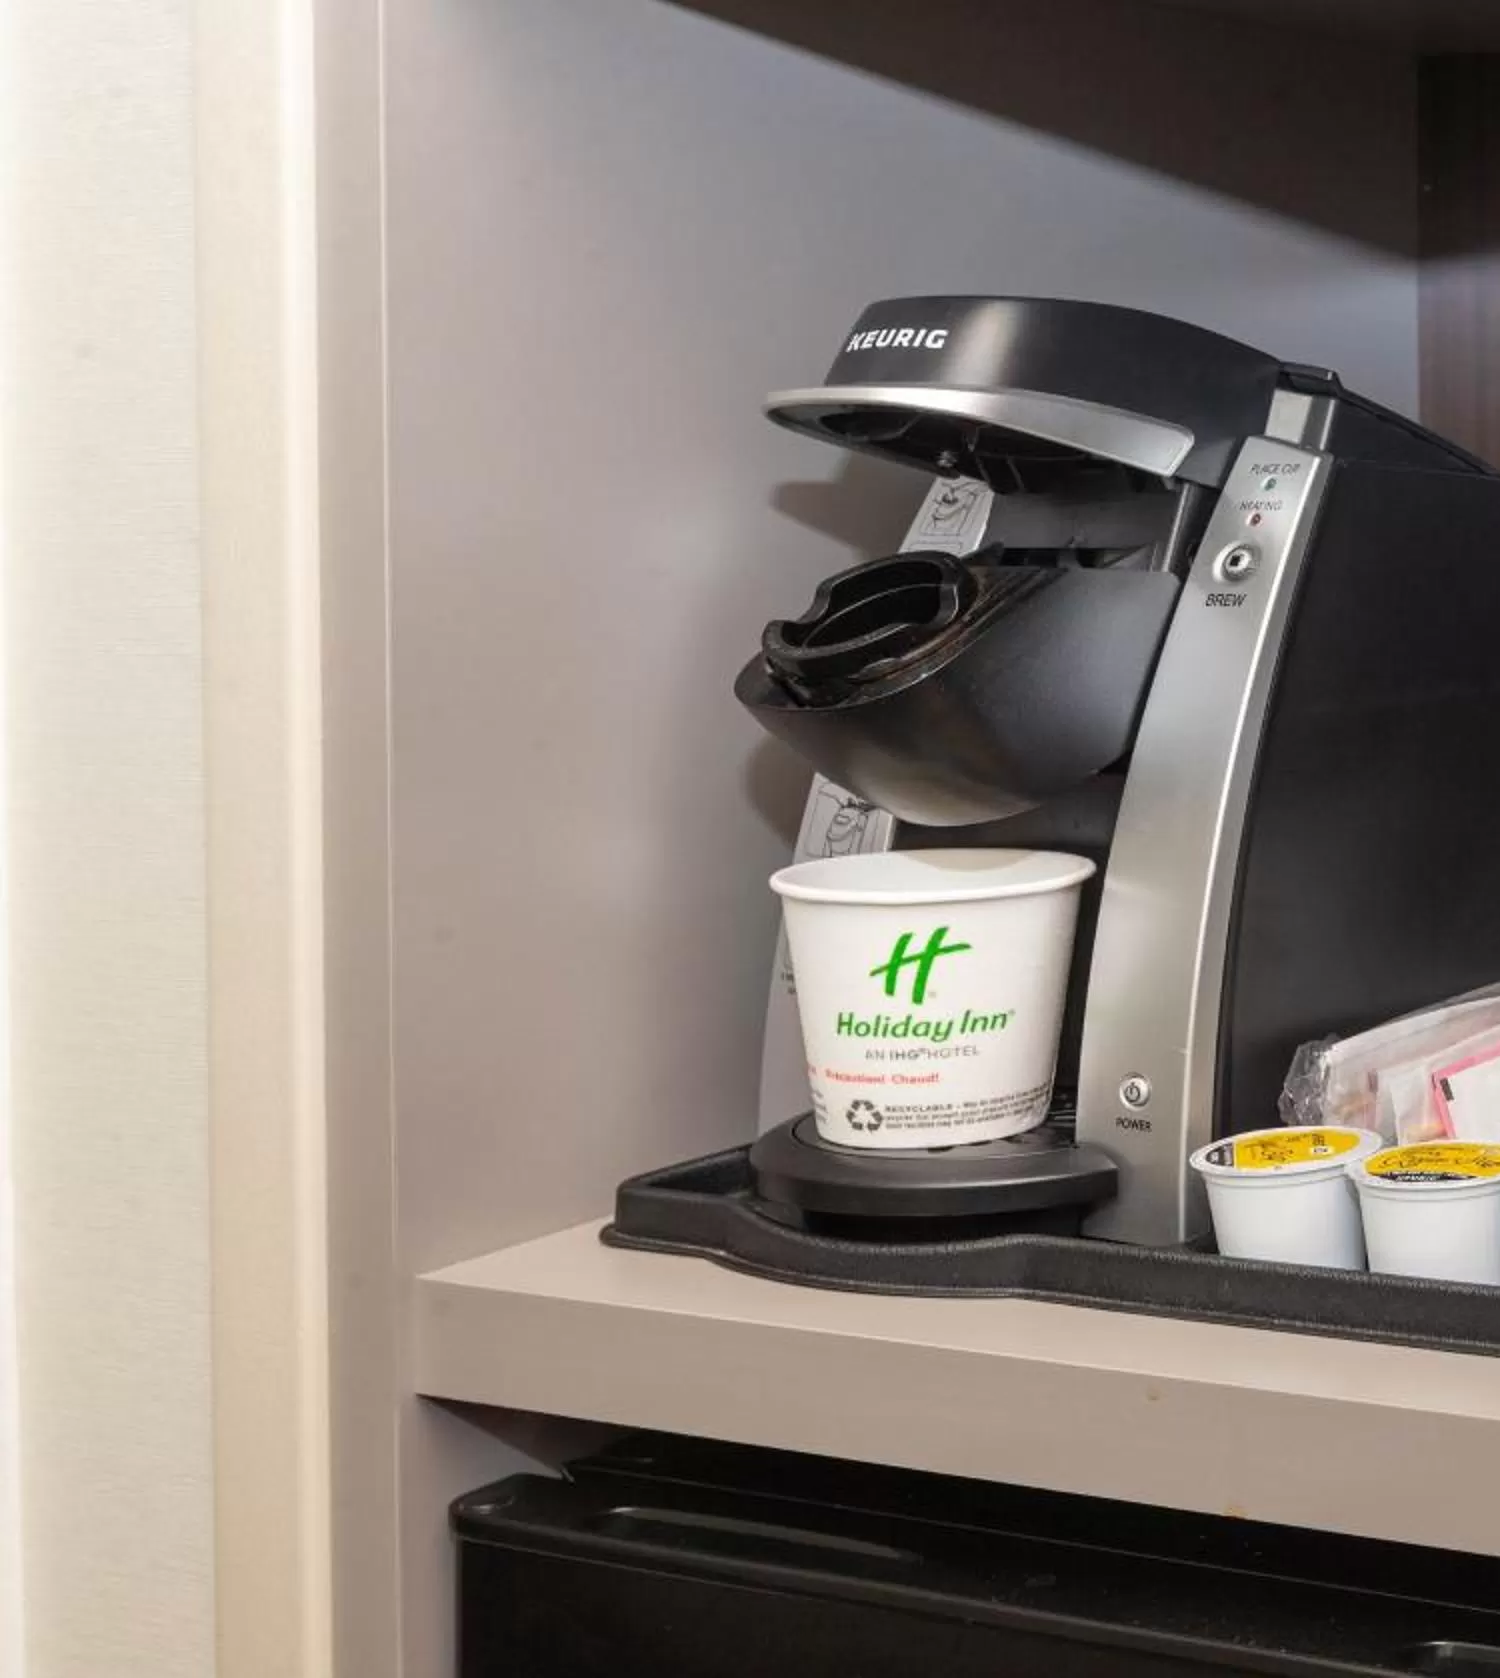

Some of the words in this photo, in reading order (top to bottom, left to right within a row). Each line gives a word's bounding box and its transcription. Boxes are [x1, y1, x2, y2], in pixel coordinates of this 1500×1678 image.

[845, 328, 949, 353] KEURIG
[1250, 463, 1279, 475] PLACE
[1281, 463, 1301, 474] CUP
[1205, 593, 1247, 608] BREW
[836, 1011, 953, 1043] Holiday
[865, 1048, 885, 1061] AN
[927, 1044, 981, 1060] HOTEL
[1115, 1116, 1153, 1133] POWER
